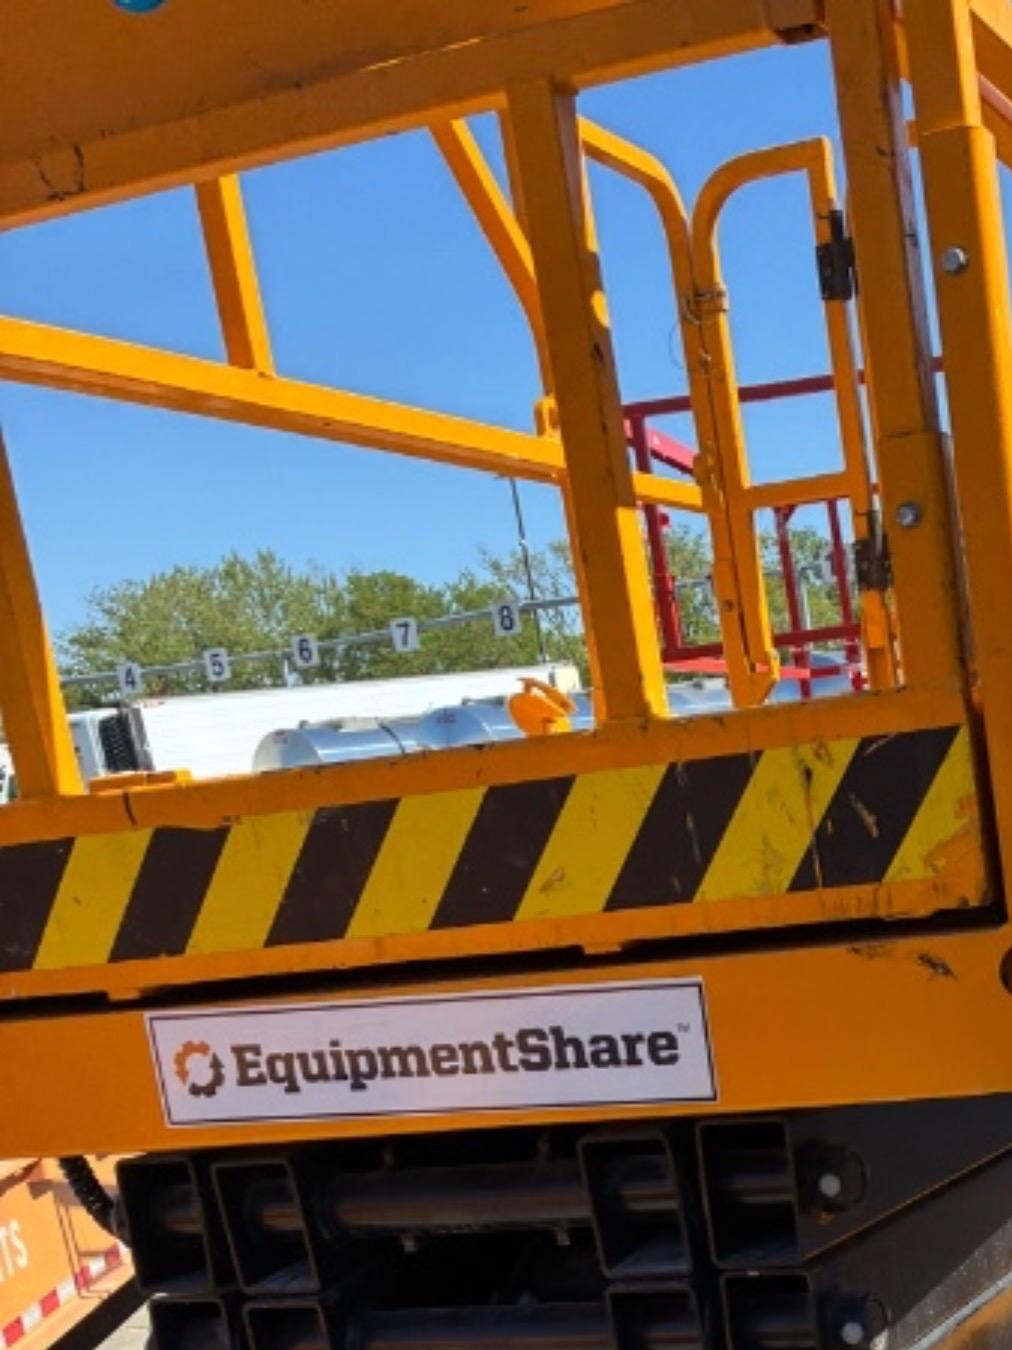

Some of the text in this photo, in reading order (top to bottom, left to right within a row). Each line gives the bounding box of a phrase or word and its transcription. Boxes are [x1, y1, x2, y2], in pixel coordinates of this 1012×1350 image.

[499, 605, 515, 631] 8
[396, 621, 410, 647] 7
[298, 637, 312, 663] 6
[209, 653, 225, 676] 5
[124, 666, 136, 690] 4
[231, 1026, 680, 1093] EquipmentShare
